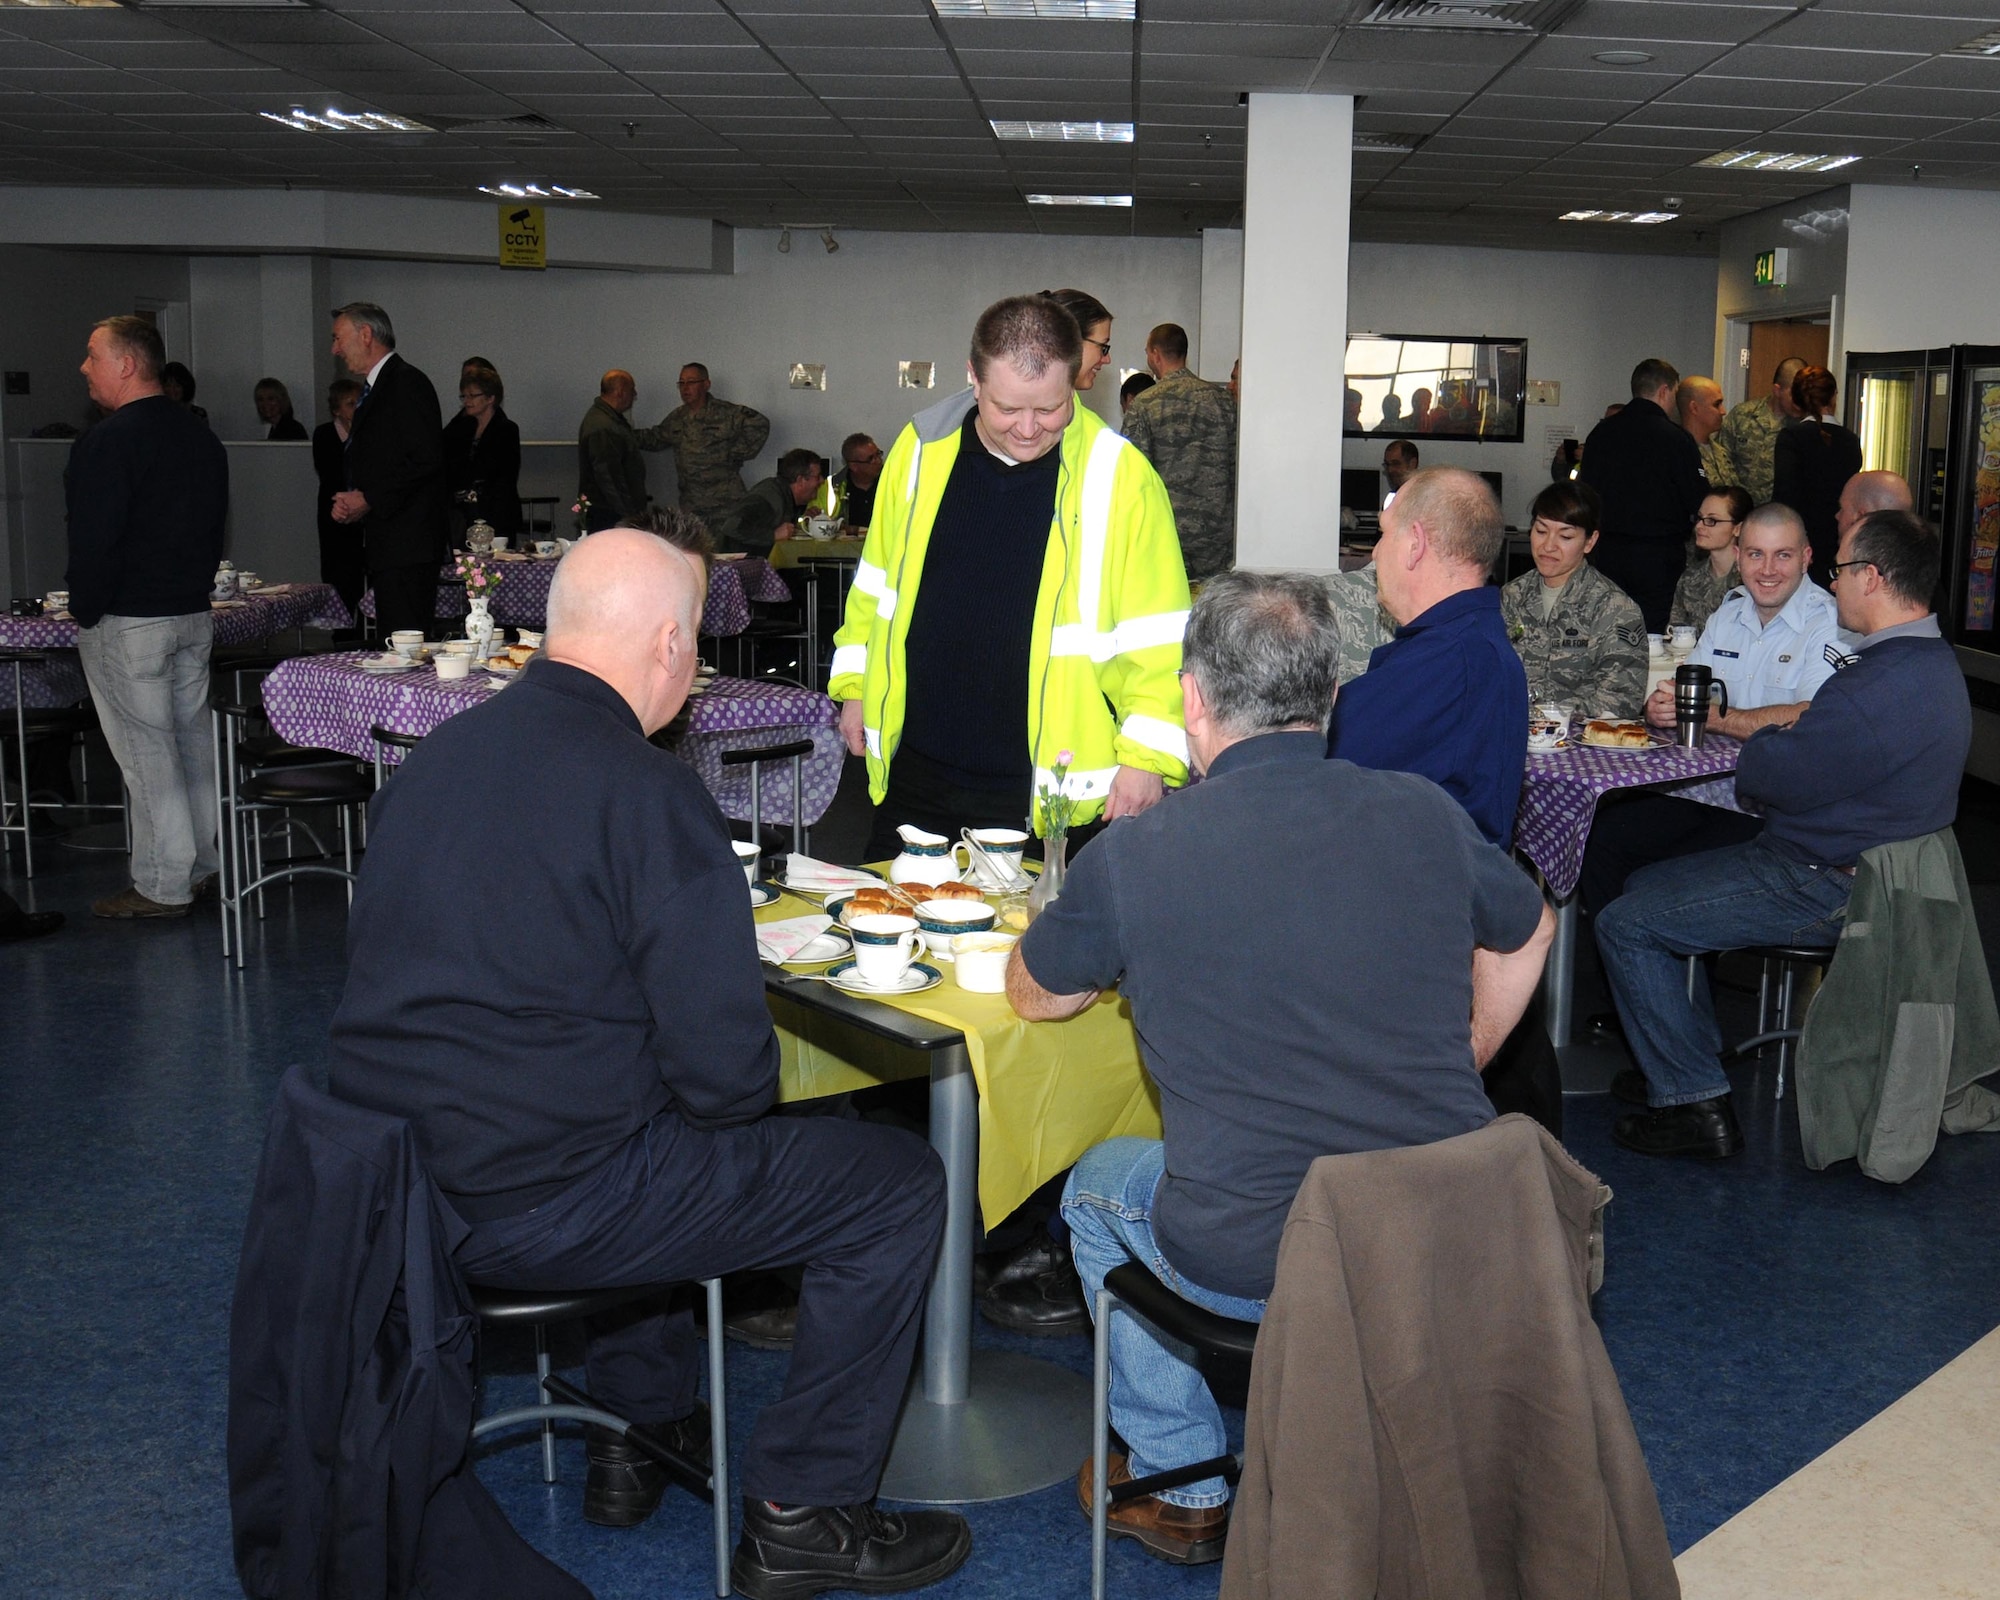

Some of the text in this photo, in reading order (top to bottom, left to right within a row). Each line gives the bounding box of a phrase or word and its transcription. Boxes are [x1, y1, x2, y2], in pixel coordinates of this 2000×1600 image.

[505, 233, 539, 246] CCTV
[1562, 639, 1572, 648] AIR
[1573, 639, 1589, 648] FOR
